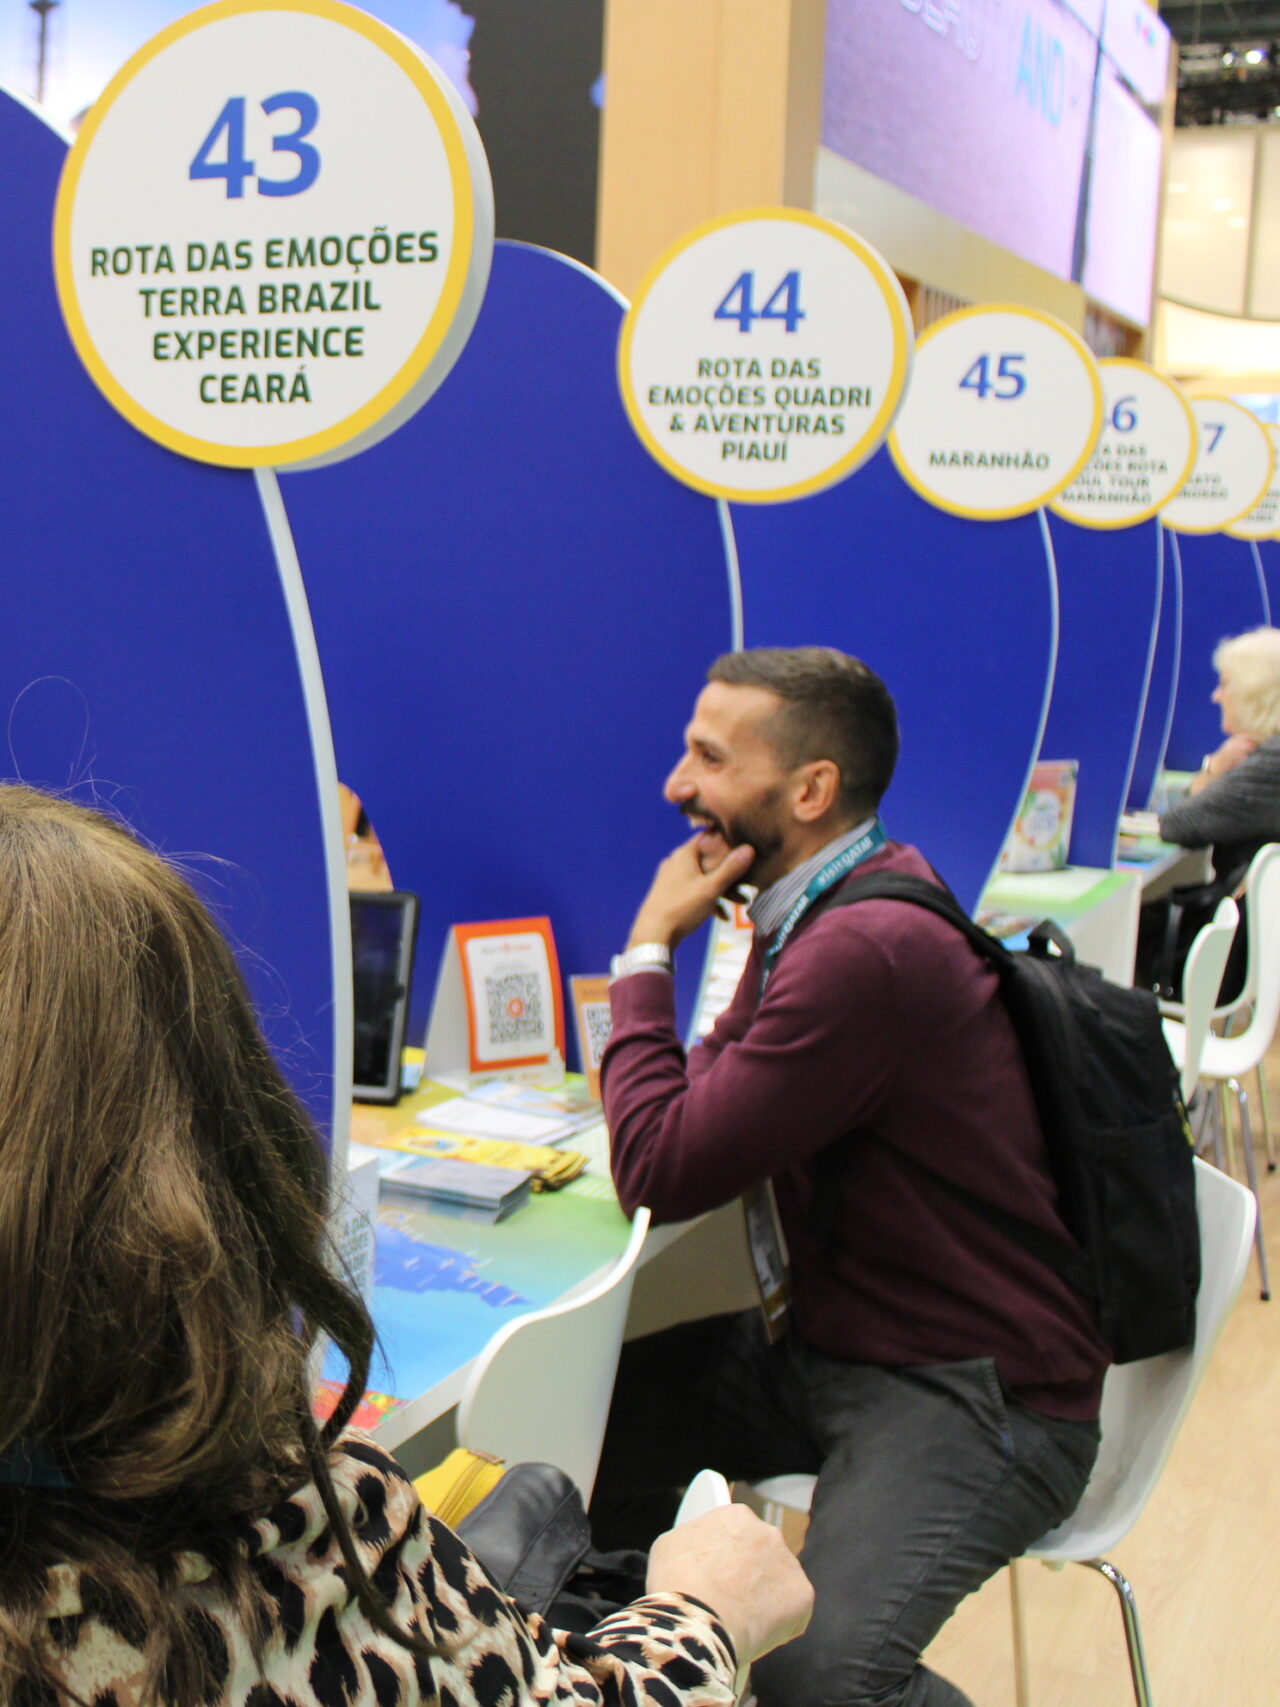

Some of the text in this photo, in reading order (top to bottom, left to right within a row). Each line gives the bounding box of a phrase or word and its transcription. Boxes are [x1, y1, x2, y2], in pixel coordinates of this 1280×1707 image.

[188, 90, 322, 200] 43
[90, 225, 439, 277] ROTA DAS EMOÇÕES
[139, 279, 381, 318] TERRA BRAZIL
[712, 269, 807, 334] 44
[152, 325, 365, 361] EXPERIENCE
[200, 365, 312, 404] CEARÁ
[697, 358, 821, 379] ROTA DAS
[958, 353, 1028, 400] 45
[648, 381, 872, 412] EMOÇÕES QUADRI
[1104, 396, 1138, 432] 6
[669, 413, 846, 435] & AVENTURAS
[721, 438, 788, 462] PIAUÍ
[928, 450, 1052, 470] MARANHÃO
